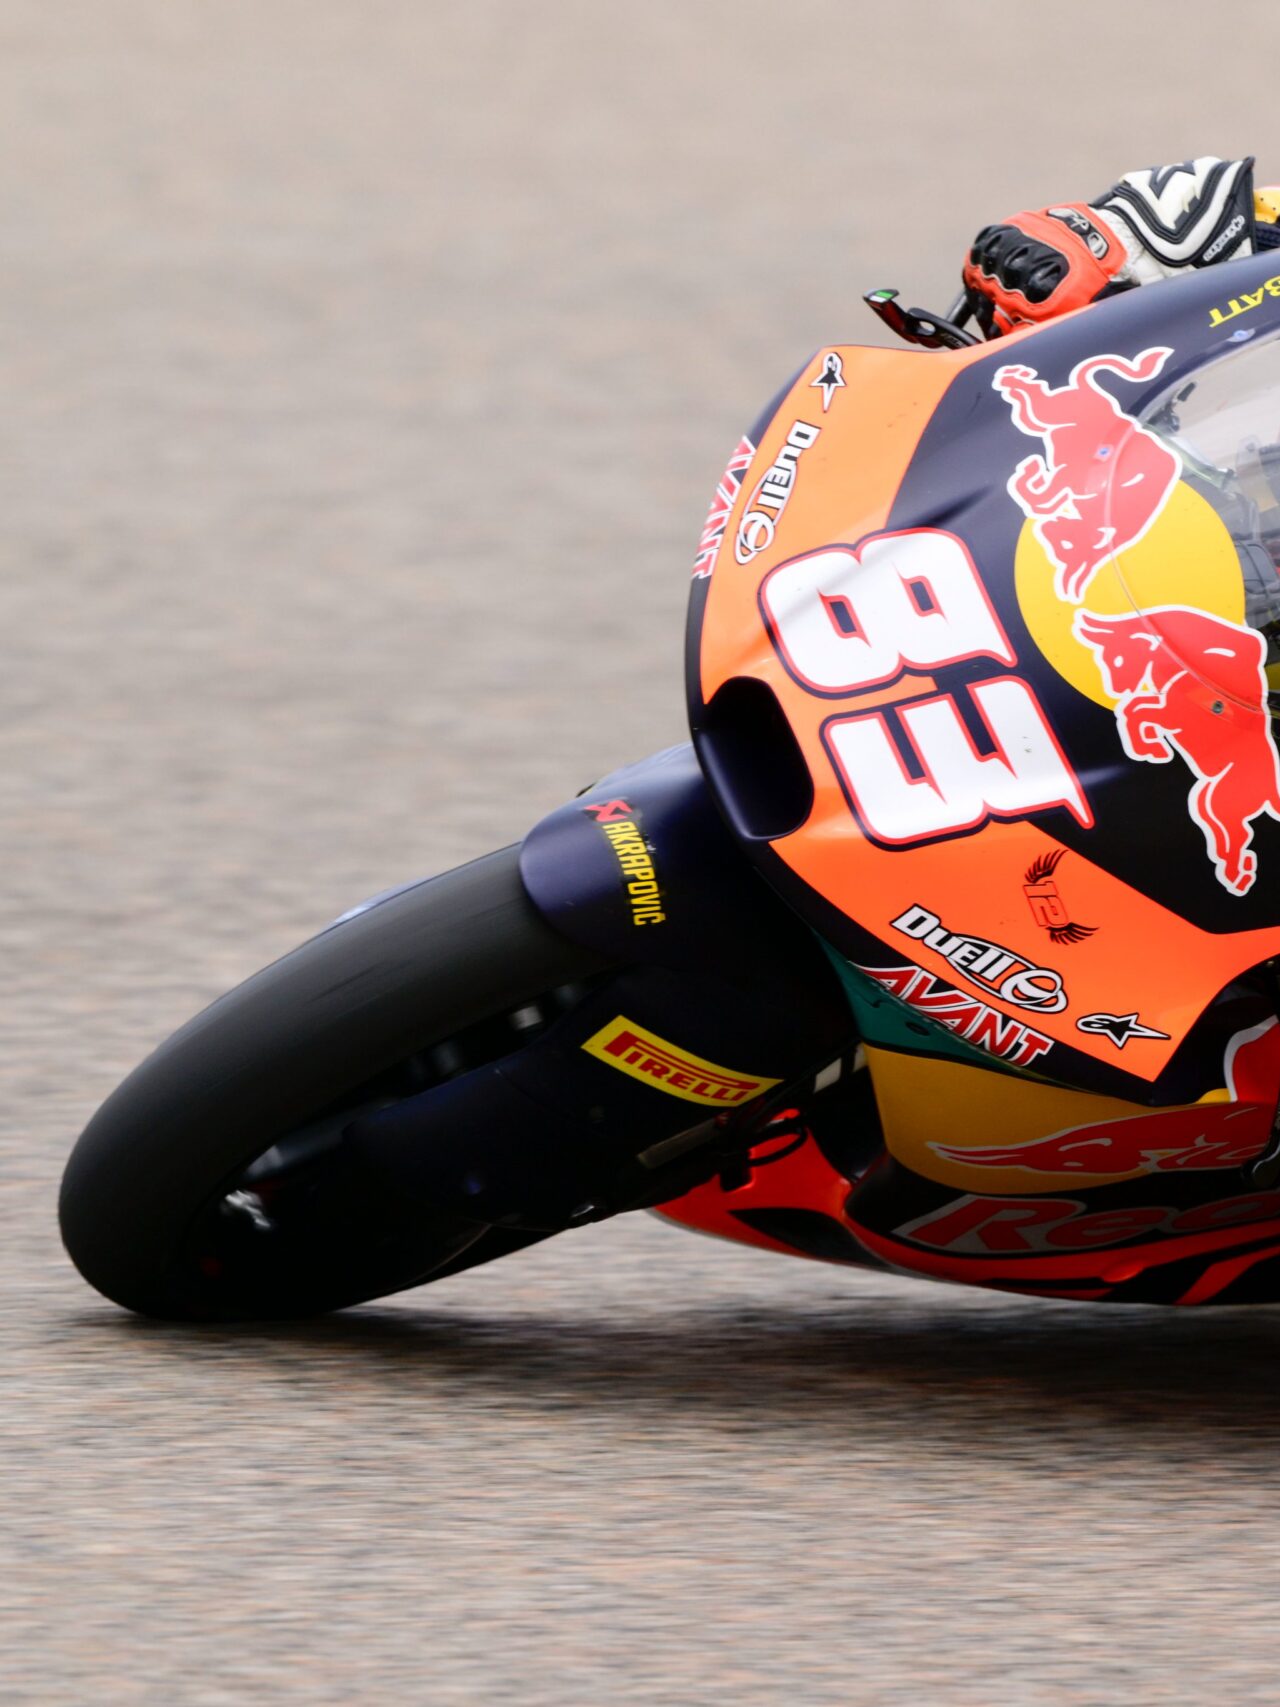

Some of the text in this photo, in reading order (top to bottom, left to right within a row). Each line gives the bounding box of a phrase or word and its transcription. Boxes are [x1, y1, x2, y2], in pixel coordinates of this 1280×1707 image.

[758, 527, 1094, 851] 83
[603, 1030, 761, 1103] PIRELLI
[847, 960, 1055, 1067] AVANT
